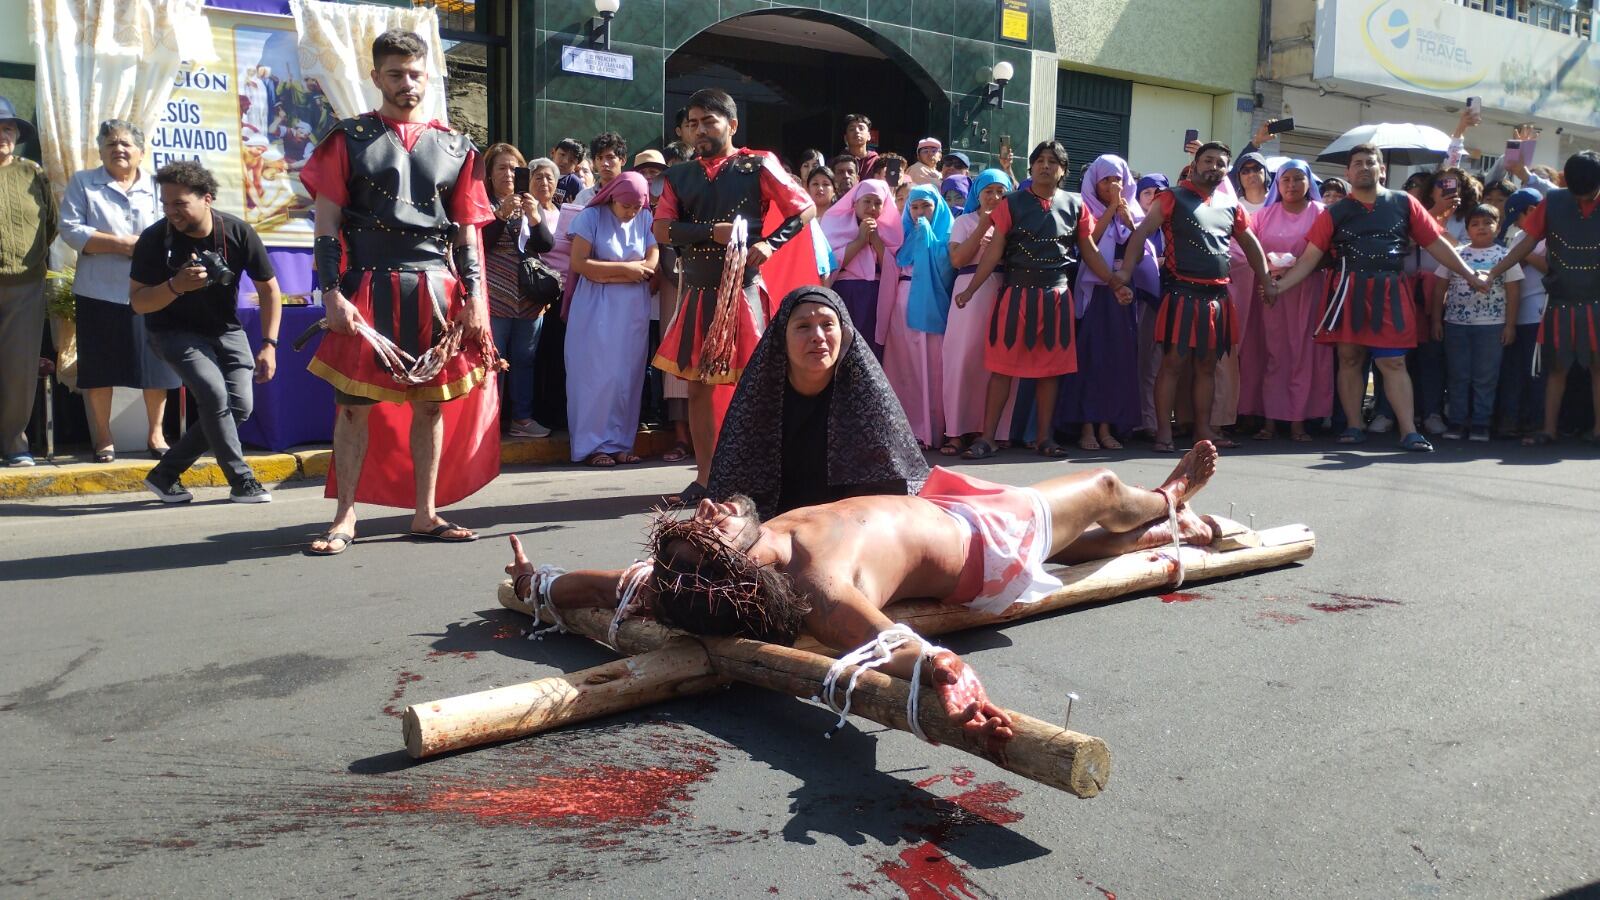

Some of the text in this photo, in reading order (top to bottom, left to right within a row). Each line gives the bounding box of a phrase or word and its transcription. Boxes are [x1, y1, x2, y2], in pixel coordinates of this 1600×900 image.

[1416, 38, 1472, 65] TRAVEL
[174, 67, 227, 90] CIÓN
[160, 99, 201, 124] SÚS
[151, 127, 228, 152] CLAVADO
